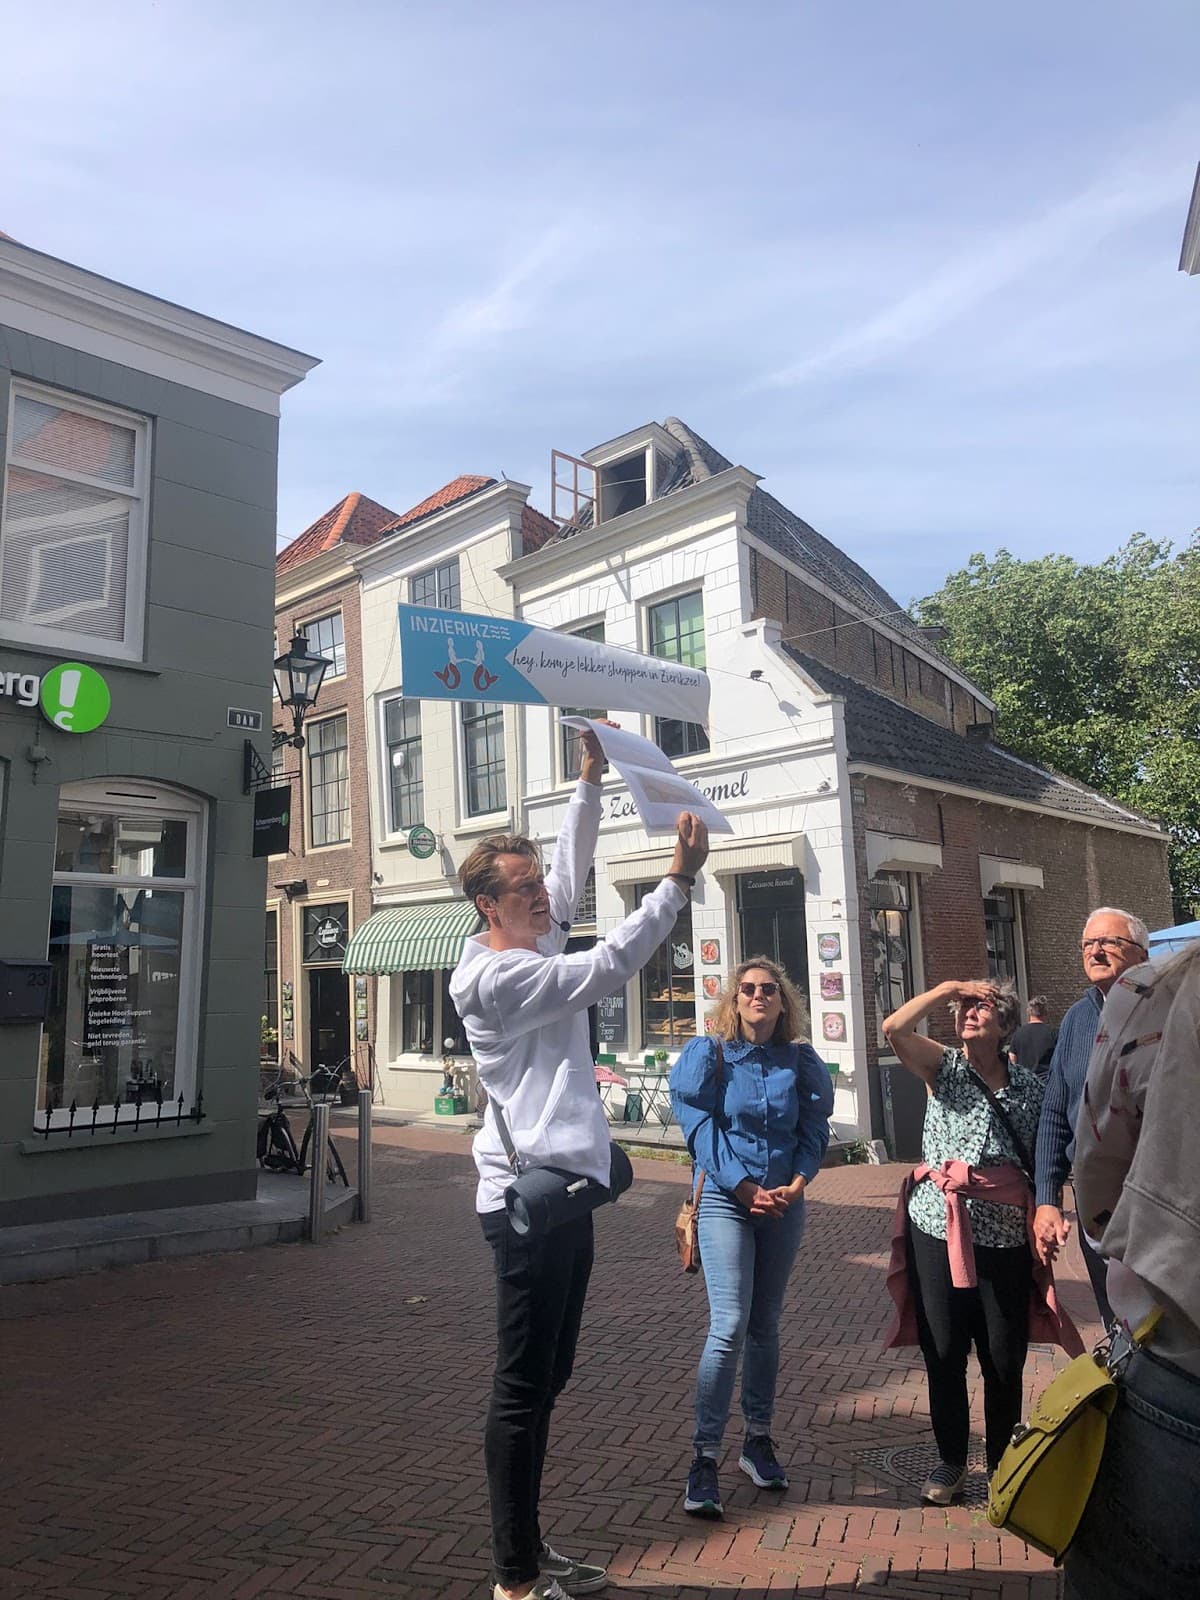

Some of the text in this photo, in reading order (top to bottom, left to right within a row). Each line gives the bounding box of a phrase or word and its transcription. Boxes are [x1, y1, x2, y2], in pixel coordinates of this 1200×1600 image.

[577, 656, 606, 673] lekker
[607, 660, 647, 683] shoppen
[648, 672, 658, 680] in
[0, 671, 40, 707] rg
[235, 713, 254, 727] DAM
[693, 770, 750, 801] emel
[27, 972, 47, 986] 23
[91, 973, 128, 981] technologie
[89, 987, 126, 995] Vrijblijvend
[89, 995, 127, 1003] uitproberen
[112, 1009, 152, 1017] HoorSupport
[88, 1017, 126, 1025] begeleiding
[87, 1038, 146, 1048] geld terug garantie
